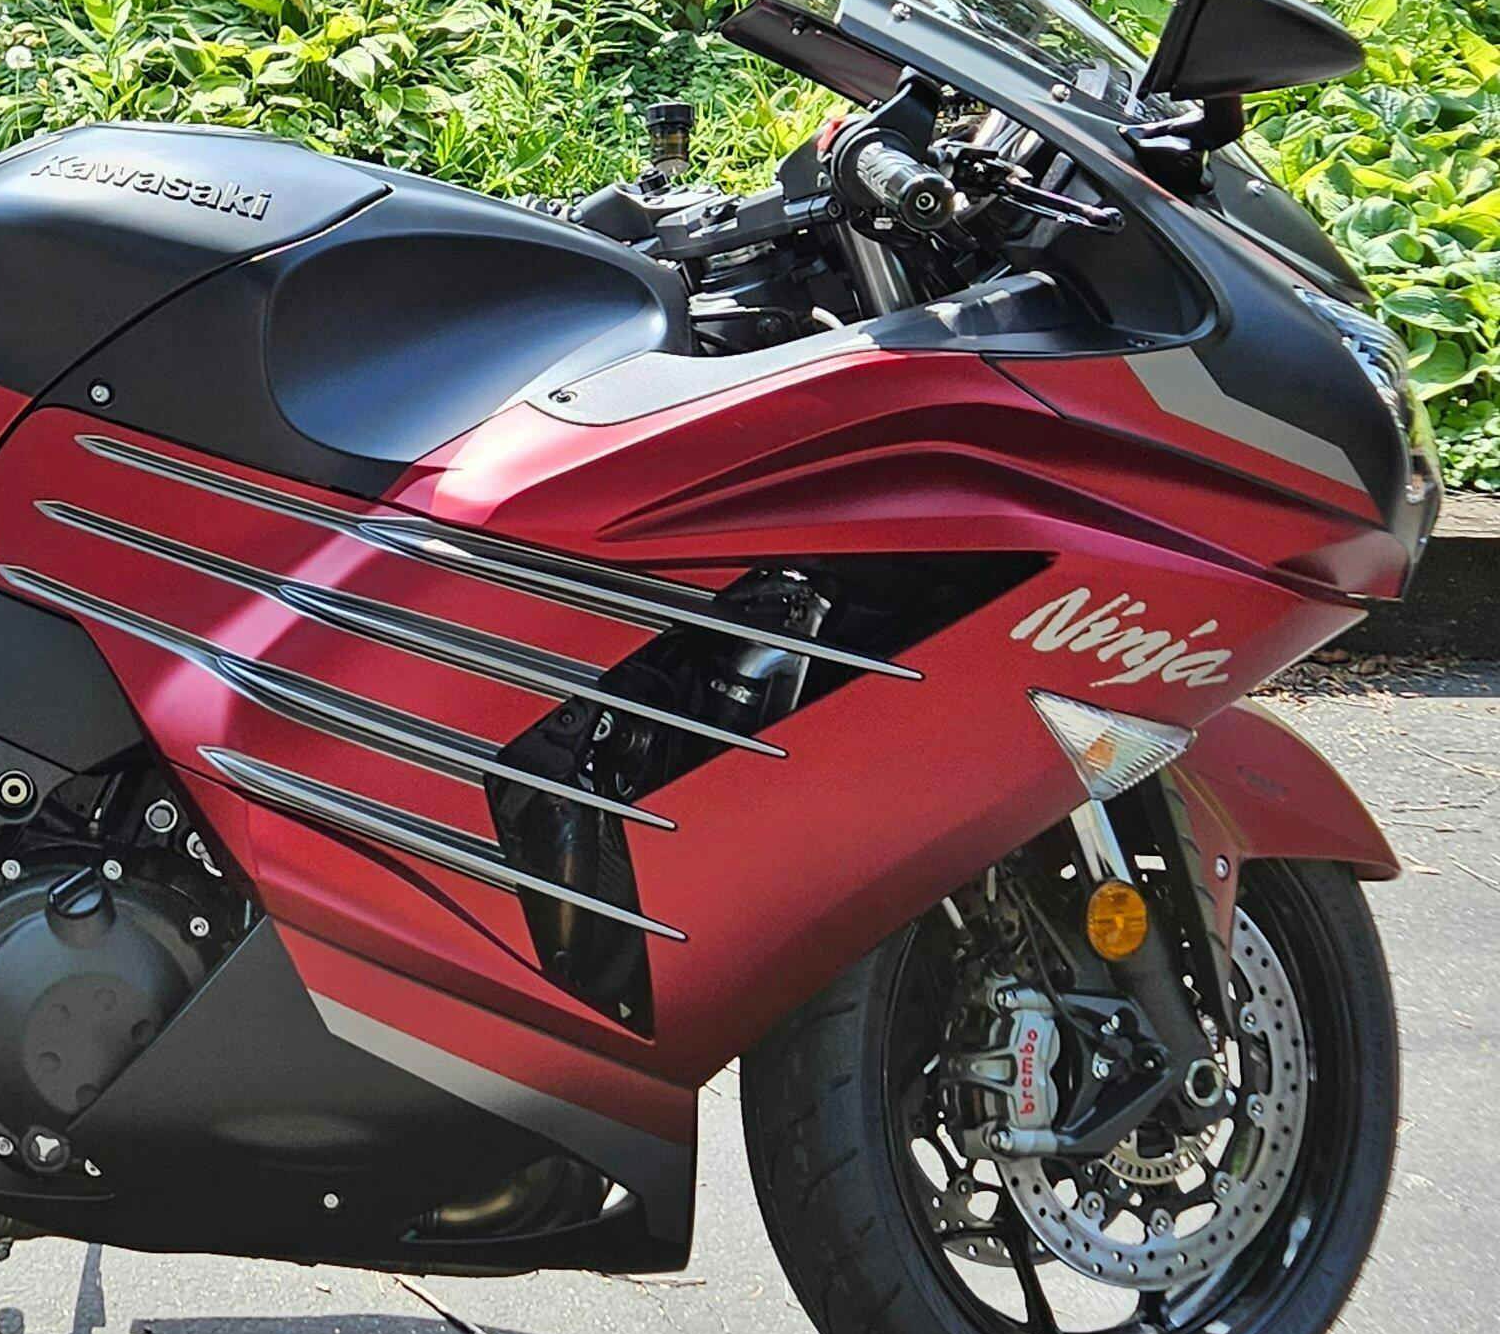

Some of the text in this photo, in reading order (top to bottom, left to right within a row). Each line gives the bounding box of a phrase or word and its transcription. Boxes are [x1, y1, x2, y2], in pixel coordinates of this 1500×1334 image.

[31, 154, 272, 221] Kawasaki
[1009, 586, 1232, 688] Ninja
[1019, 1029, 1038, 1115] brembo
